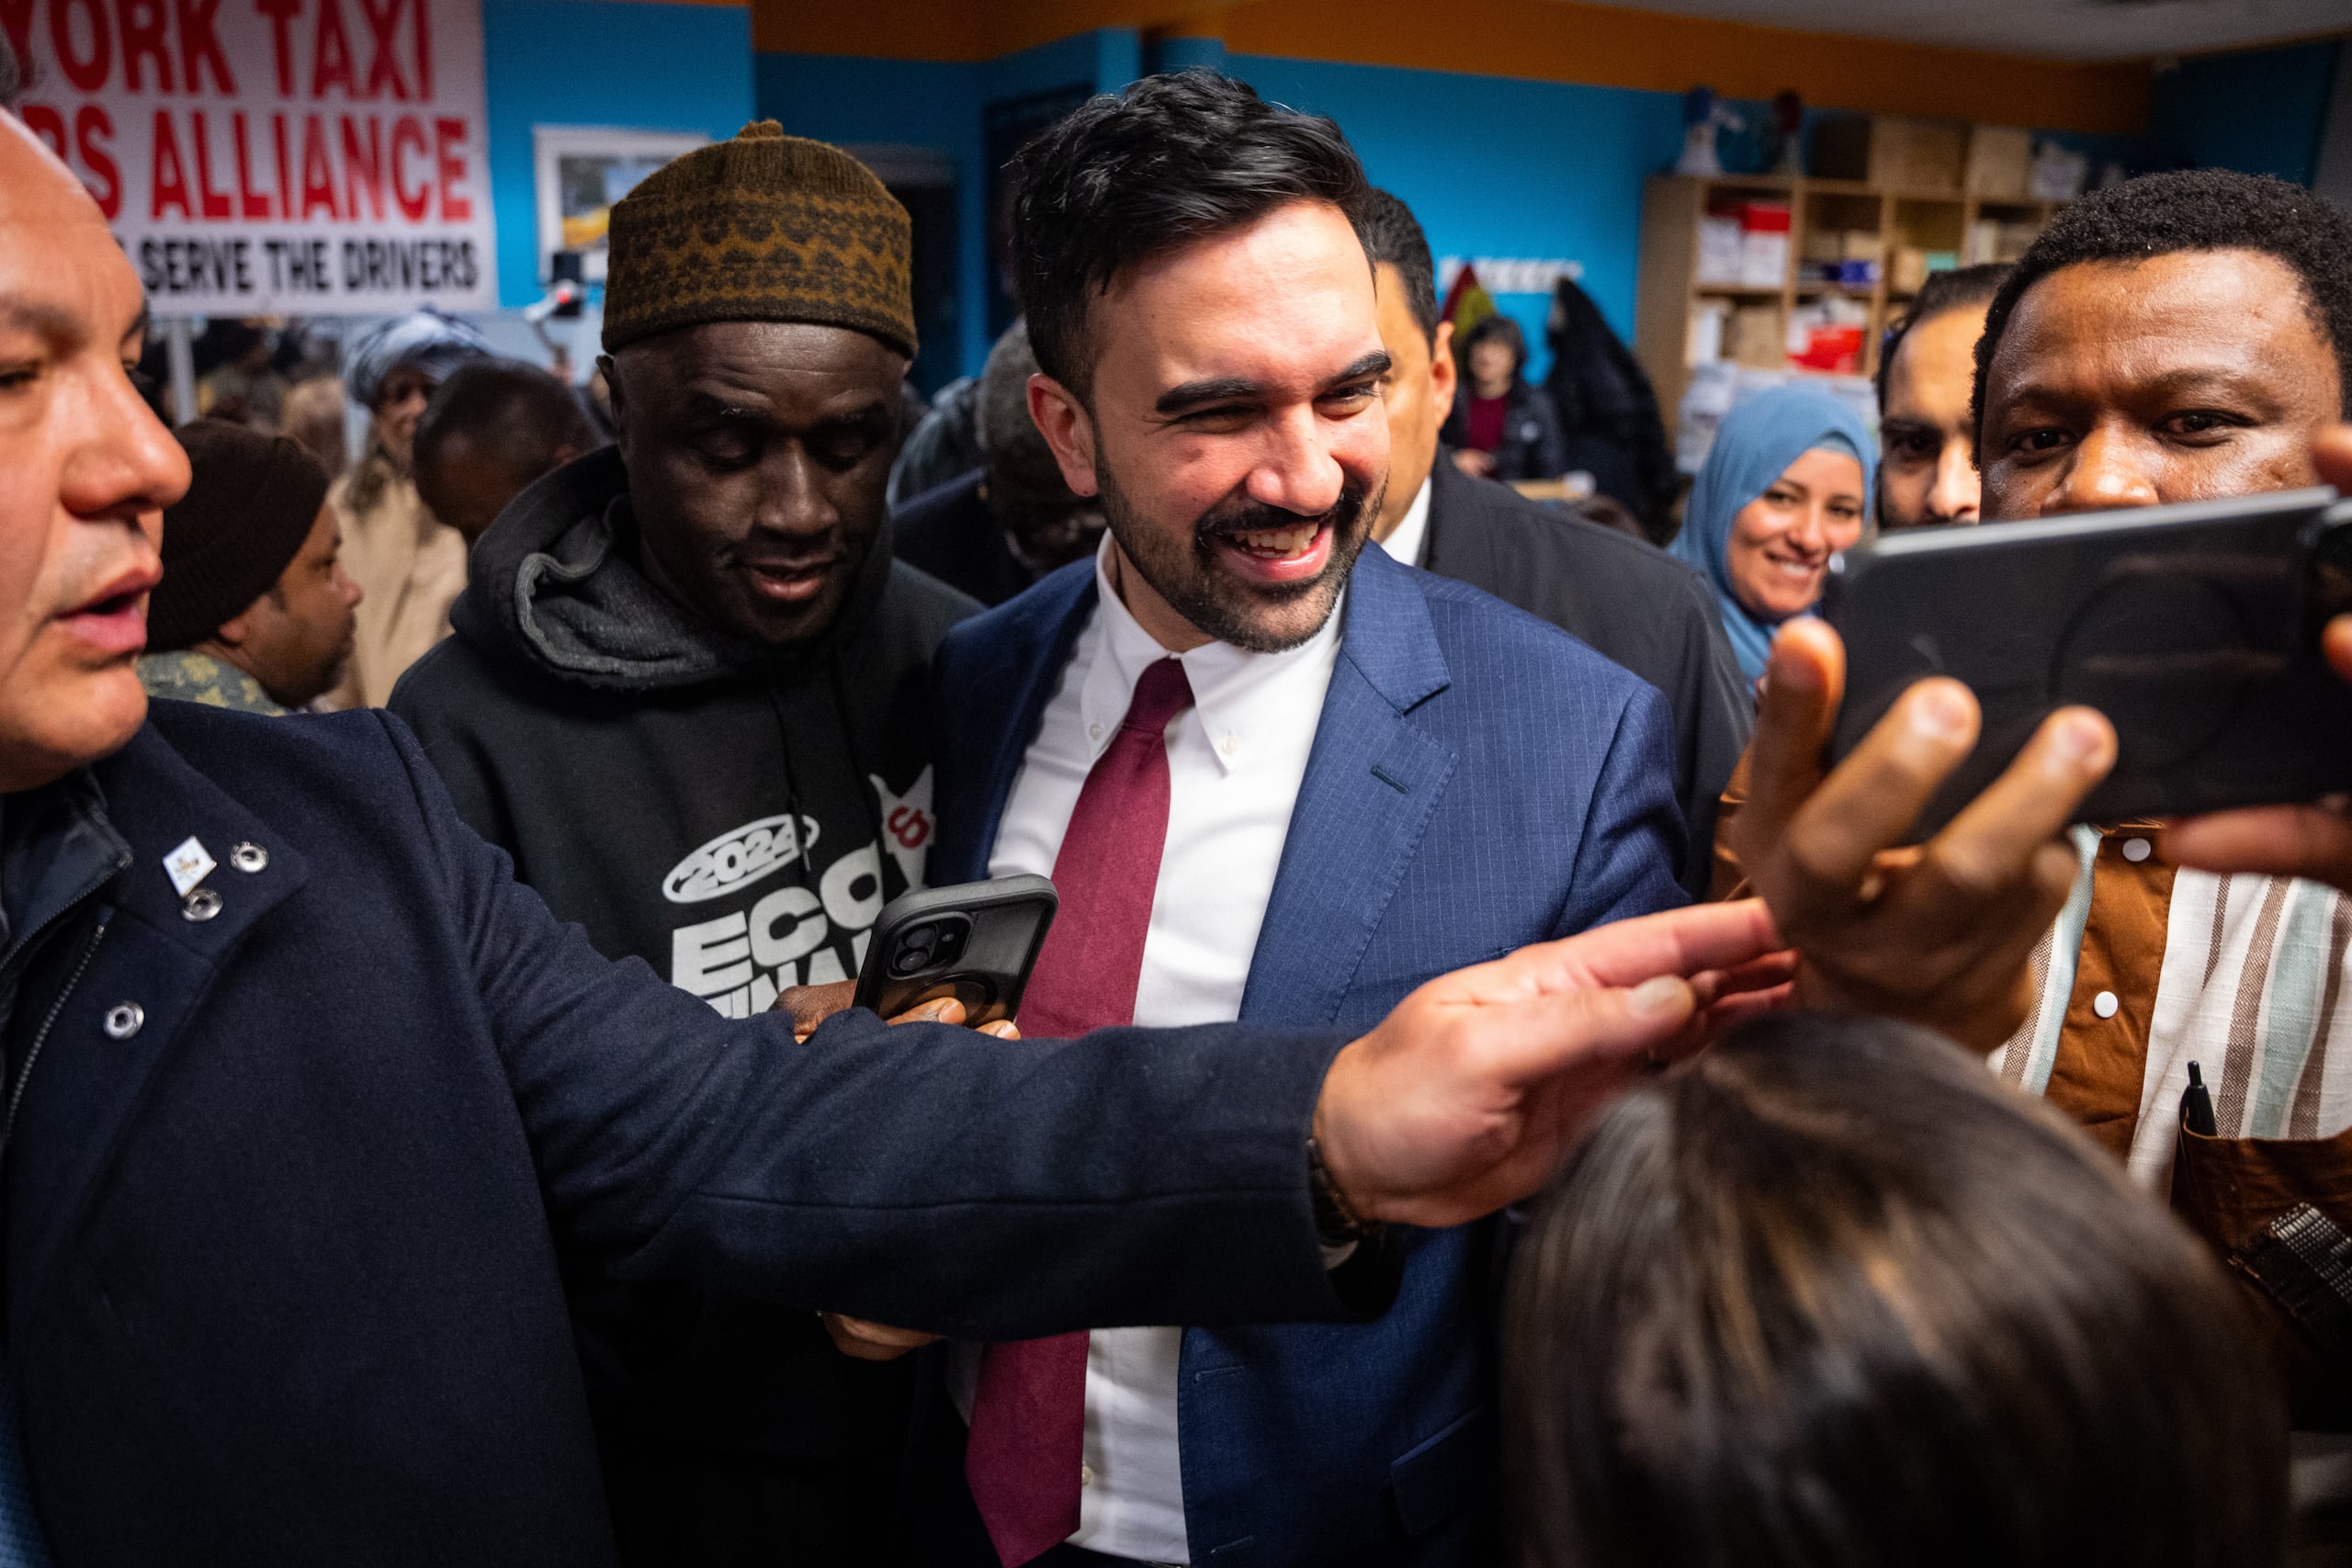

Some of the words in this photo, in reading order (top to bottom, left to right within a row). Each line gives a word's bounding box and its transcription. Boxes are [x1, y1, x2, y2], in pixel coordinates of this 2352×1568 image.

[254, 0, 433, 103] TAXI
[151, 109, 473, 223] ALLIANCE
[141, 237, 251, 292] SERVE
[265, 238, 330, 291] THE
[343, 238, 479, 292] DRIVERS
